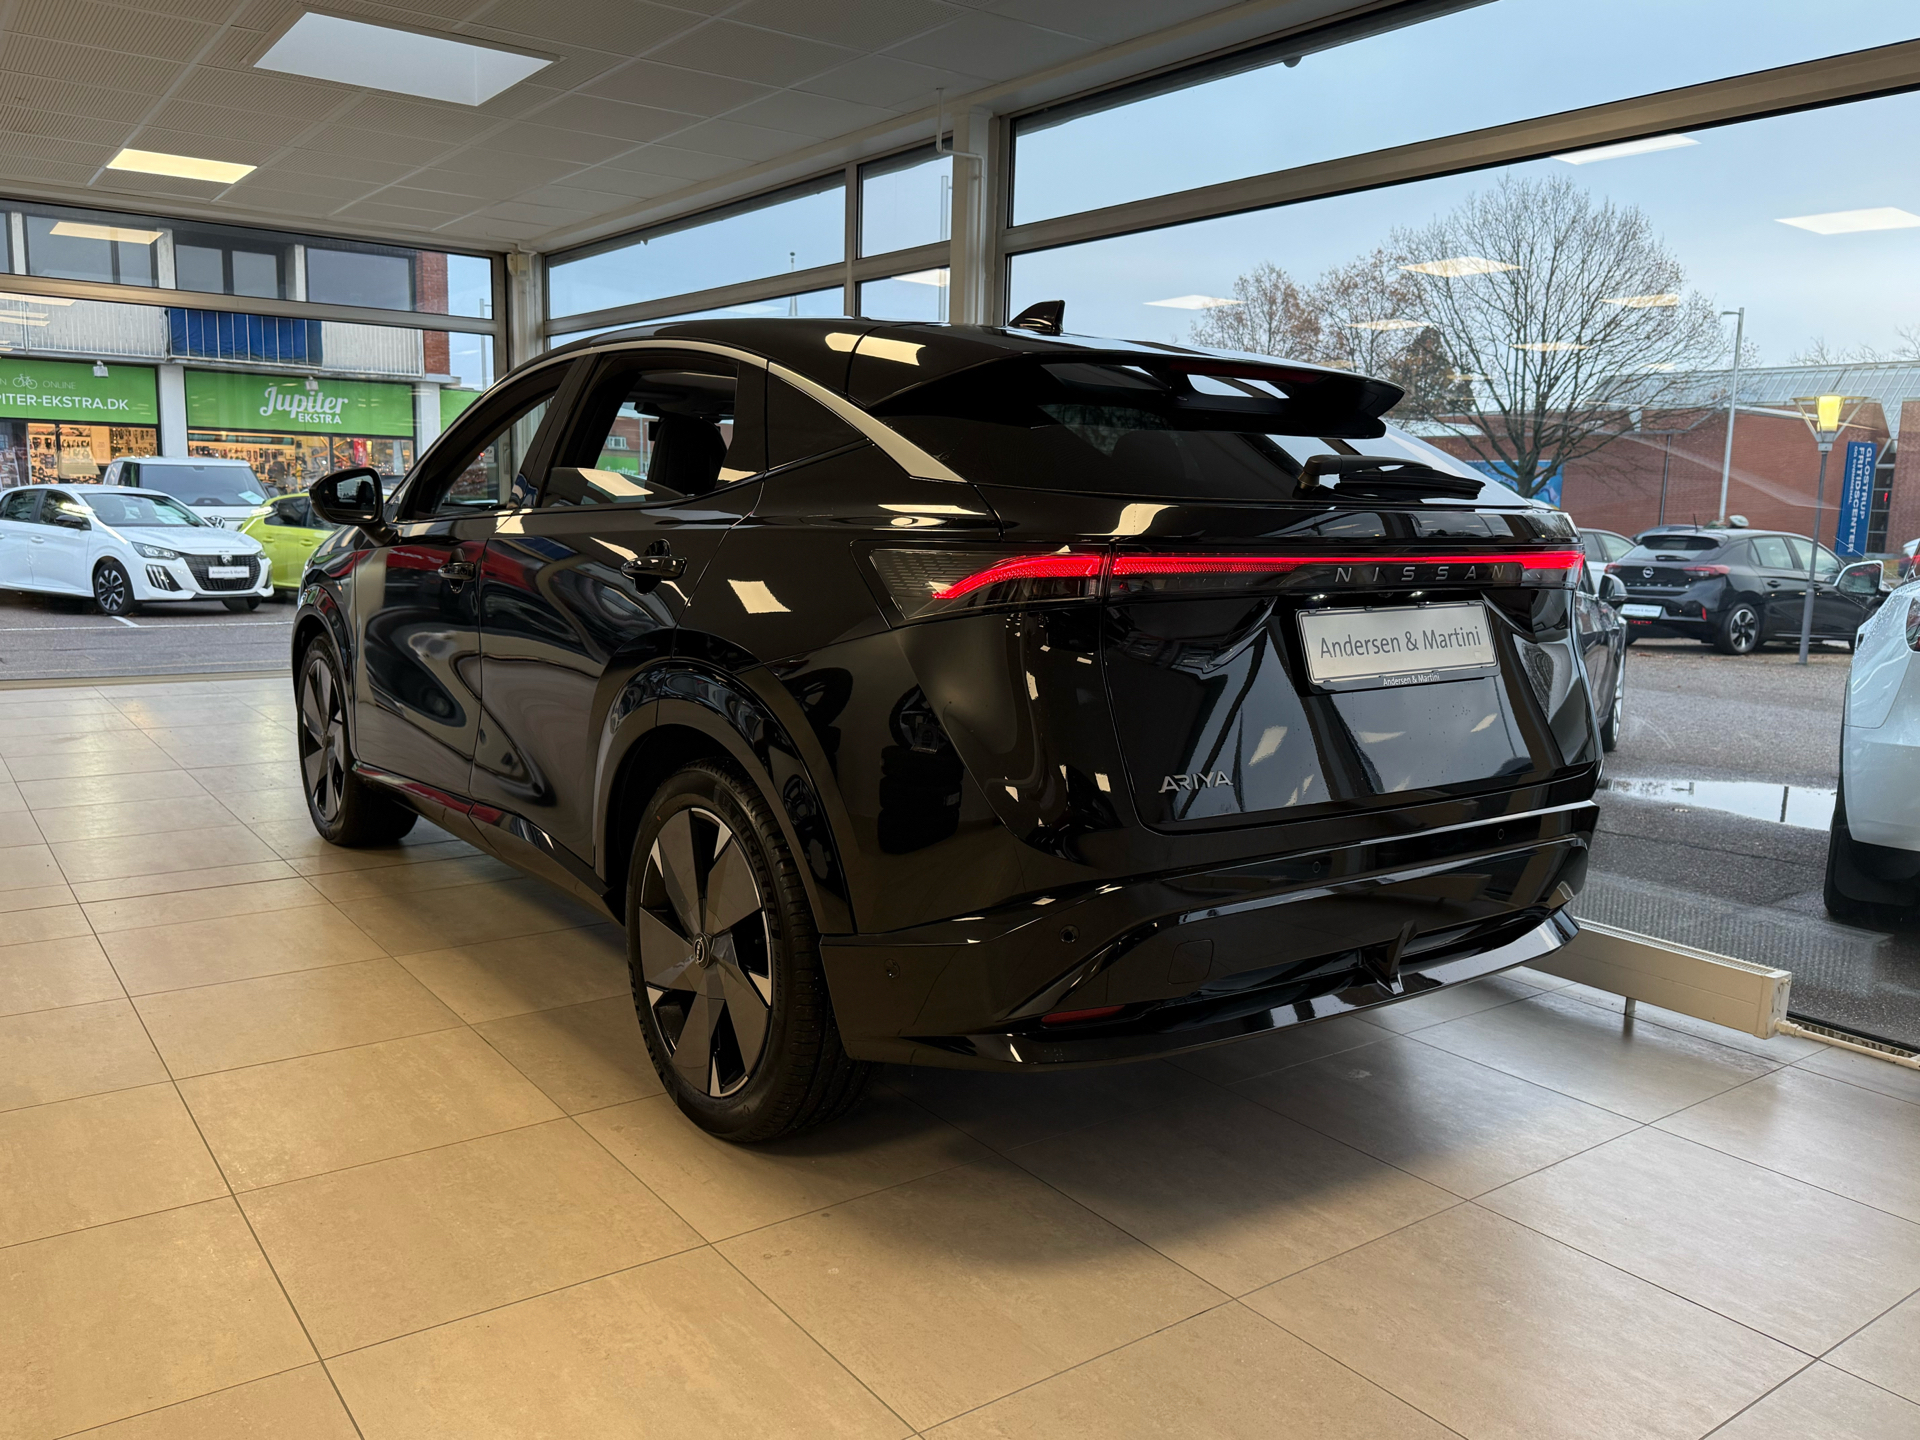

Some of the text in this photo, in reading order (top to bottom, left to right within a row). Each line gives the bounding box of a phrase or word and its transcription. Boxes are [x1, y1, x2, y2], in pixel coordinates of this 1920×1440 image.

[42, 380, 77, 390] ONLINE
[0, 393, 129, 411] ITER-EKSTRA.DK
[259, 386, 349, 419] Jupiter
[298, 413, 342, 425] EKSTRA
[1860, 447, 1873, 520] GLOSTRUP
[1847, 446, 1865, 553] FRITIDSCENTER
[1335, 565, 1504, 583] NISSAN
[1320, 626, 1482, 659] Andersen & Martini
[1383, 672, 1440, 686] Andersen & Martini
[1158, 770, 1234, 794] ARIYA
[732, 814, 780, 932] MICHELIN
